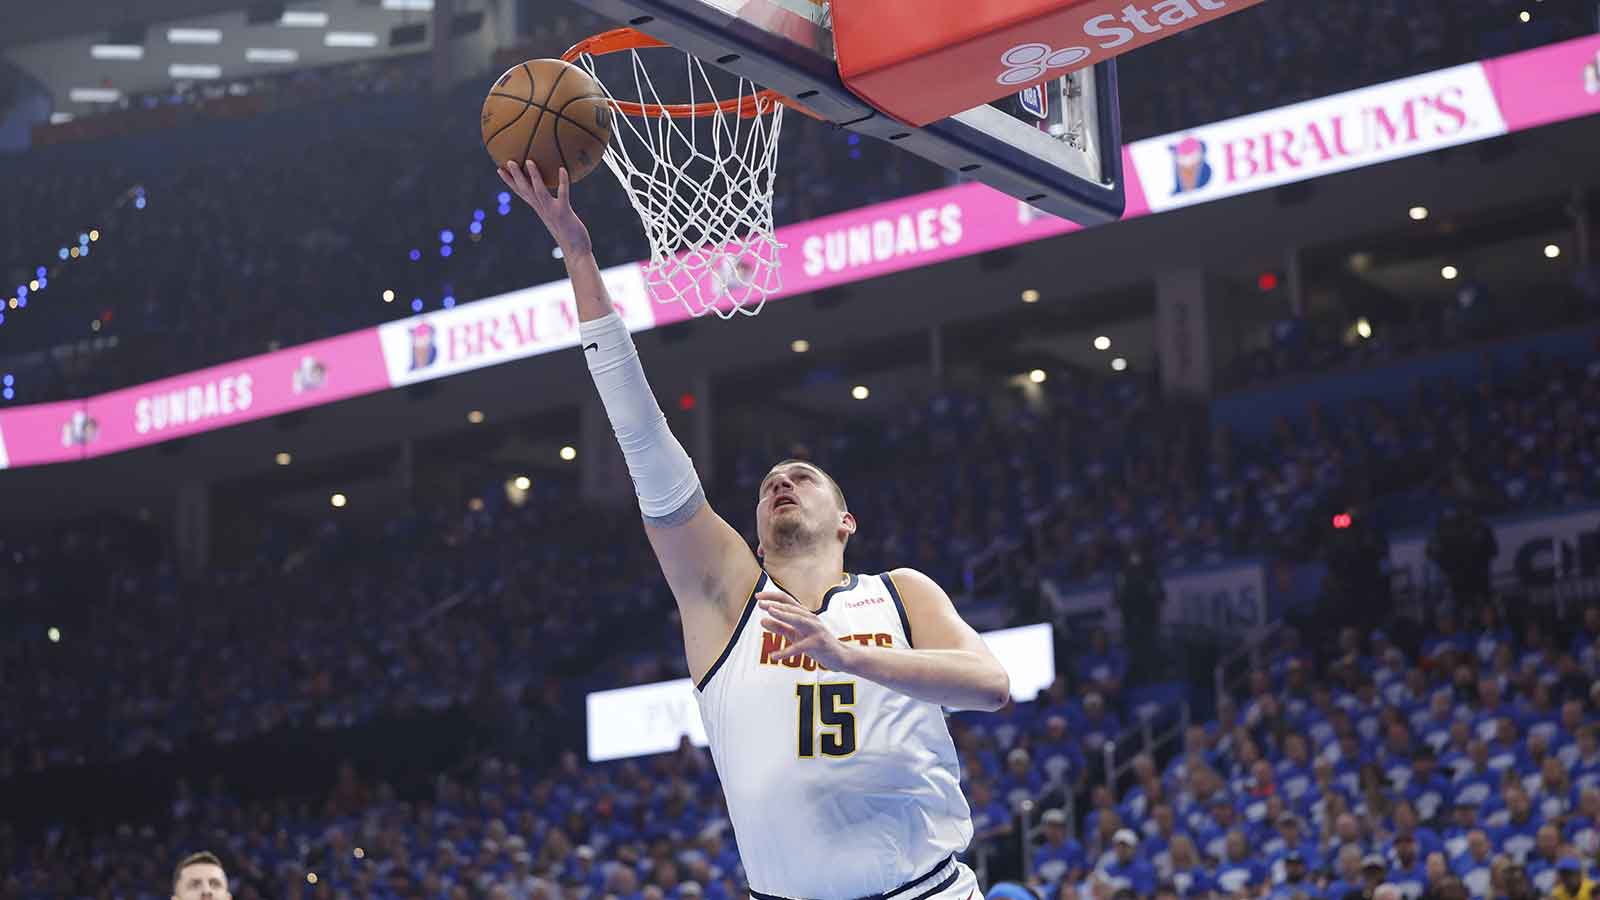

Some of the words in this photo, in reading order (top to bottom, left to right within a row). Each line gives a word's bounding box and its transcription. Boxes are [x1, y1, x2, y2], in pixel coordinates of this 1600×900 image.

[1221, 86, 1468, 183] BRAUM'S
[802, 203, 963, 277] SUNDAES
[135, 373, 253, 434] SUNDAES
[796, 681, 857, 759] 15
